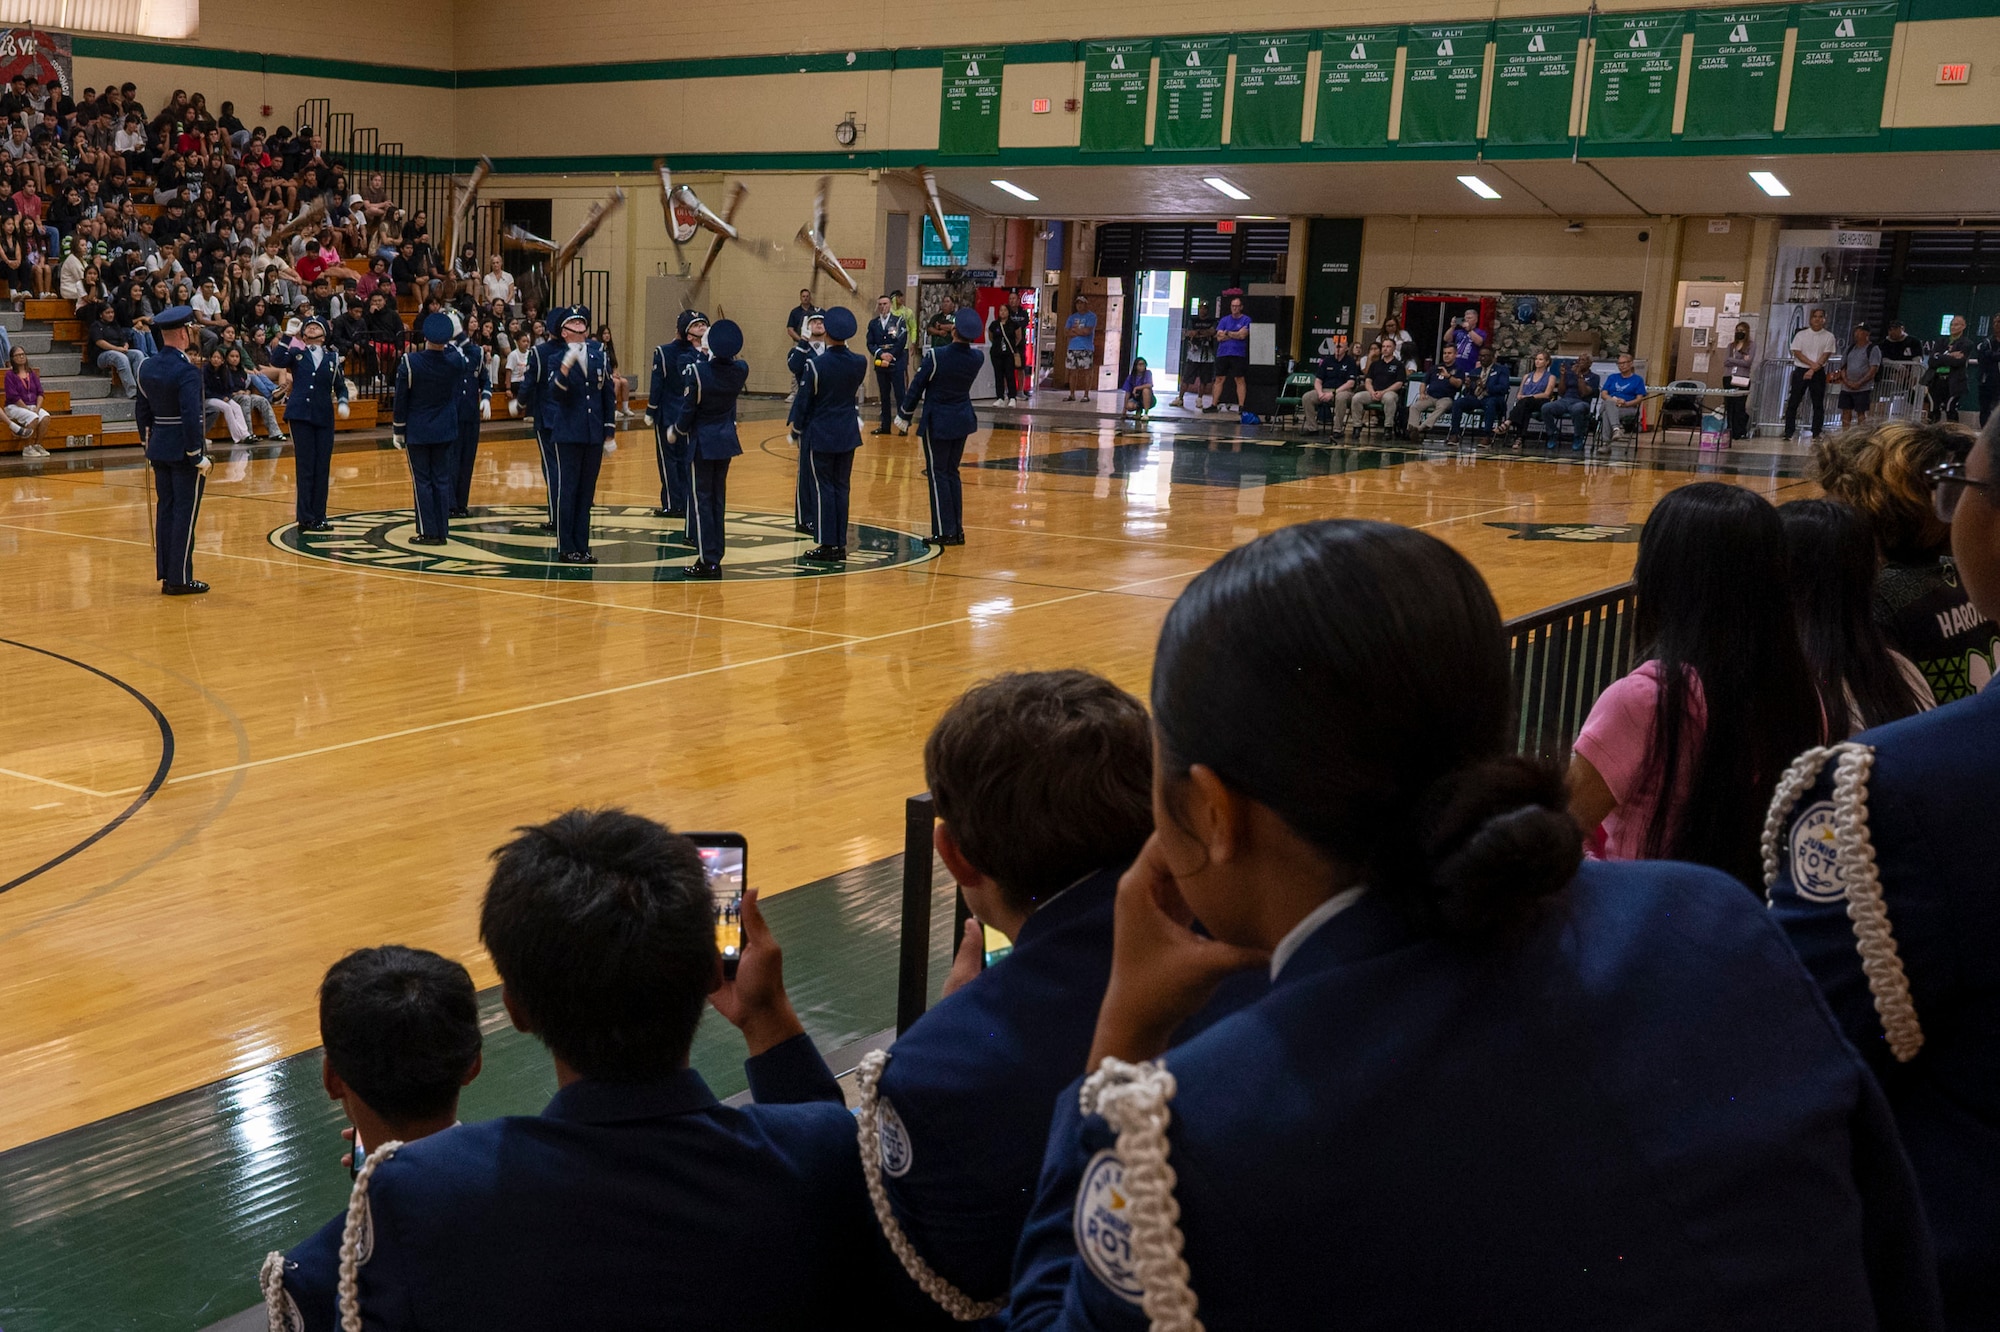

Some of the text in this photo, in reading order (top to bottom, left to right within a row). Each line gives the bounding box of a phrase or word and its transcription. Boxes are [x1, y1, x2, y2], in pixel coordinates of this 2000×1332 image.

[1942, 65, 1967, 81] EXIT
[1034, 100, 1048, 112] EXIT
[1219, 221, 1233, 232] EXIT
[1292, 376, 1311, 384] AIEA
[1803, 838, 1837, 859] JUNIO
[1088, 1218, 1130, 1262] ROT
